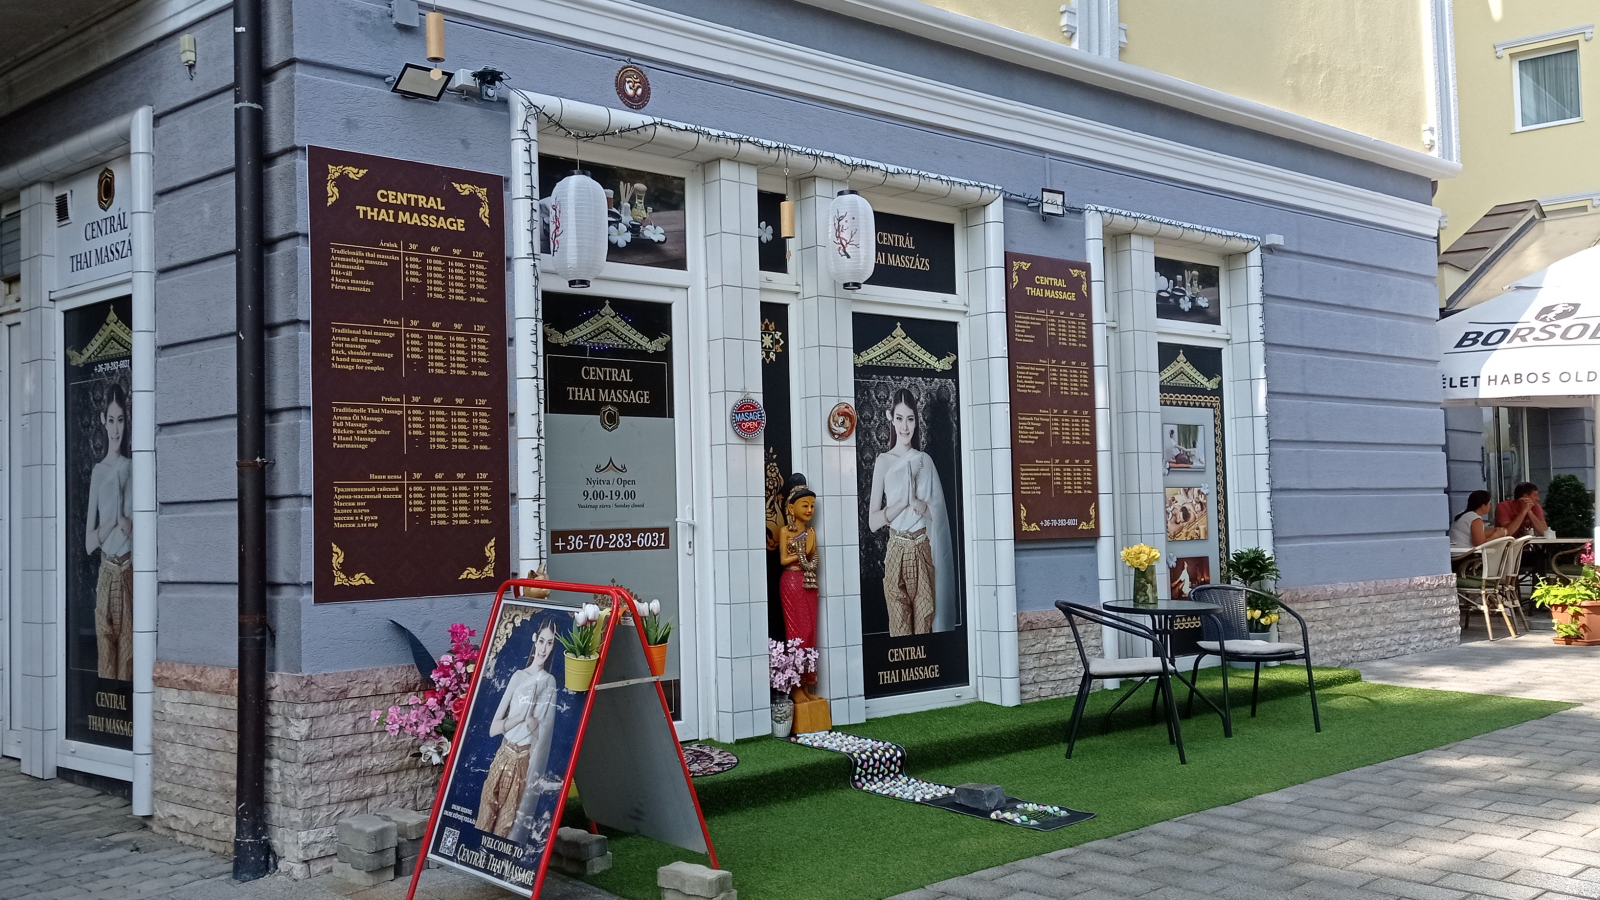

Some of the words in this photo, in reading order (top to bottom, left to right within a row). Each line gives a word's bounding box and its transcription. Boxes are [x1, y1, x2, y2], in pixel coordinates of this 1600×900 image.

[376, 189, 446, 211] CENTRAL
[84, 208, 128, 241] CENTRÁL
[356, 205, 394, 223] THAI
[398, 211, 466, 232] MASSAGE
[877, 232, 915, 249] CENTRÁL
[70, 250, 92, 273] THAI
[94, 232, 132, 266] MASSZÁ
[875, 252, 886, 264] AI
[888, 253, 930, 271] MASSZÁZS
[1035, 276, 1066, 288] CENTRAL
[1026, 286, 1043, 297] THAI
[1045, 289, 1076, 300] MASSAGE
[582, 366, 633, 382] CENTRAL
[1488, 372, 1550, 386] HABOS
[567, 387, 595, 402] THAI
[599, 389, 650, 404] MASSAGE
[735, 411, 762, 422] MASAGE
[586, 478, 611, 488] Nyitva
[616, 478, 636, 487] Open
[582, 490, 636, 500] 9.00-19.00
[555, 532, 666, 551] +36-70-283-6031
[888, 645, 926, 662] CENTRAL
[878, 670, 899, 685] THAI
[901, 665, 940, 682] MASSAGE
[96, 692, 126, 710] CENTRAL
[88, 714, 104, 732] THAI
[105, 718, 132, 737] MASSAG
[481, 835, 513, 855] WELCOME
[514, 846, 523, 858] TO
